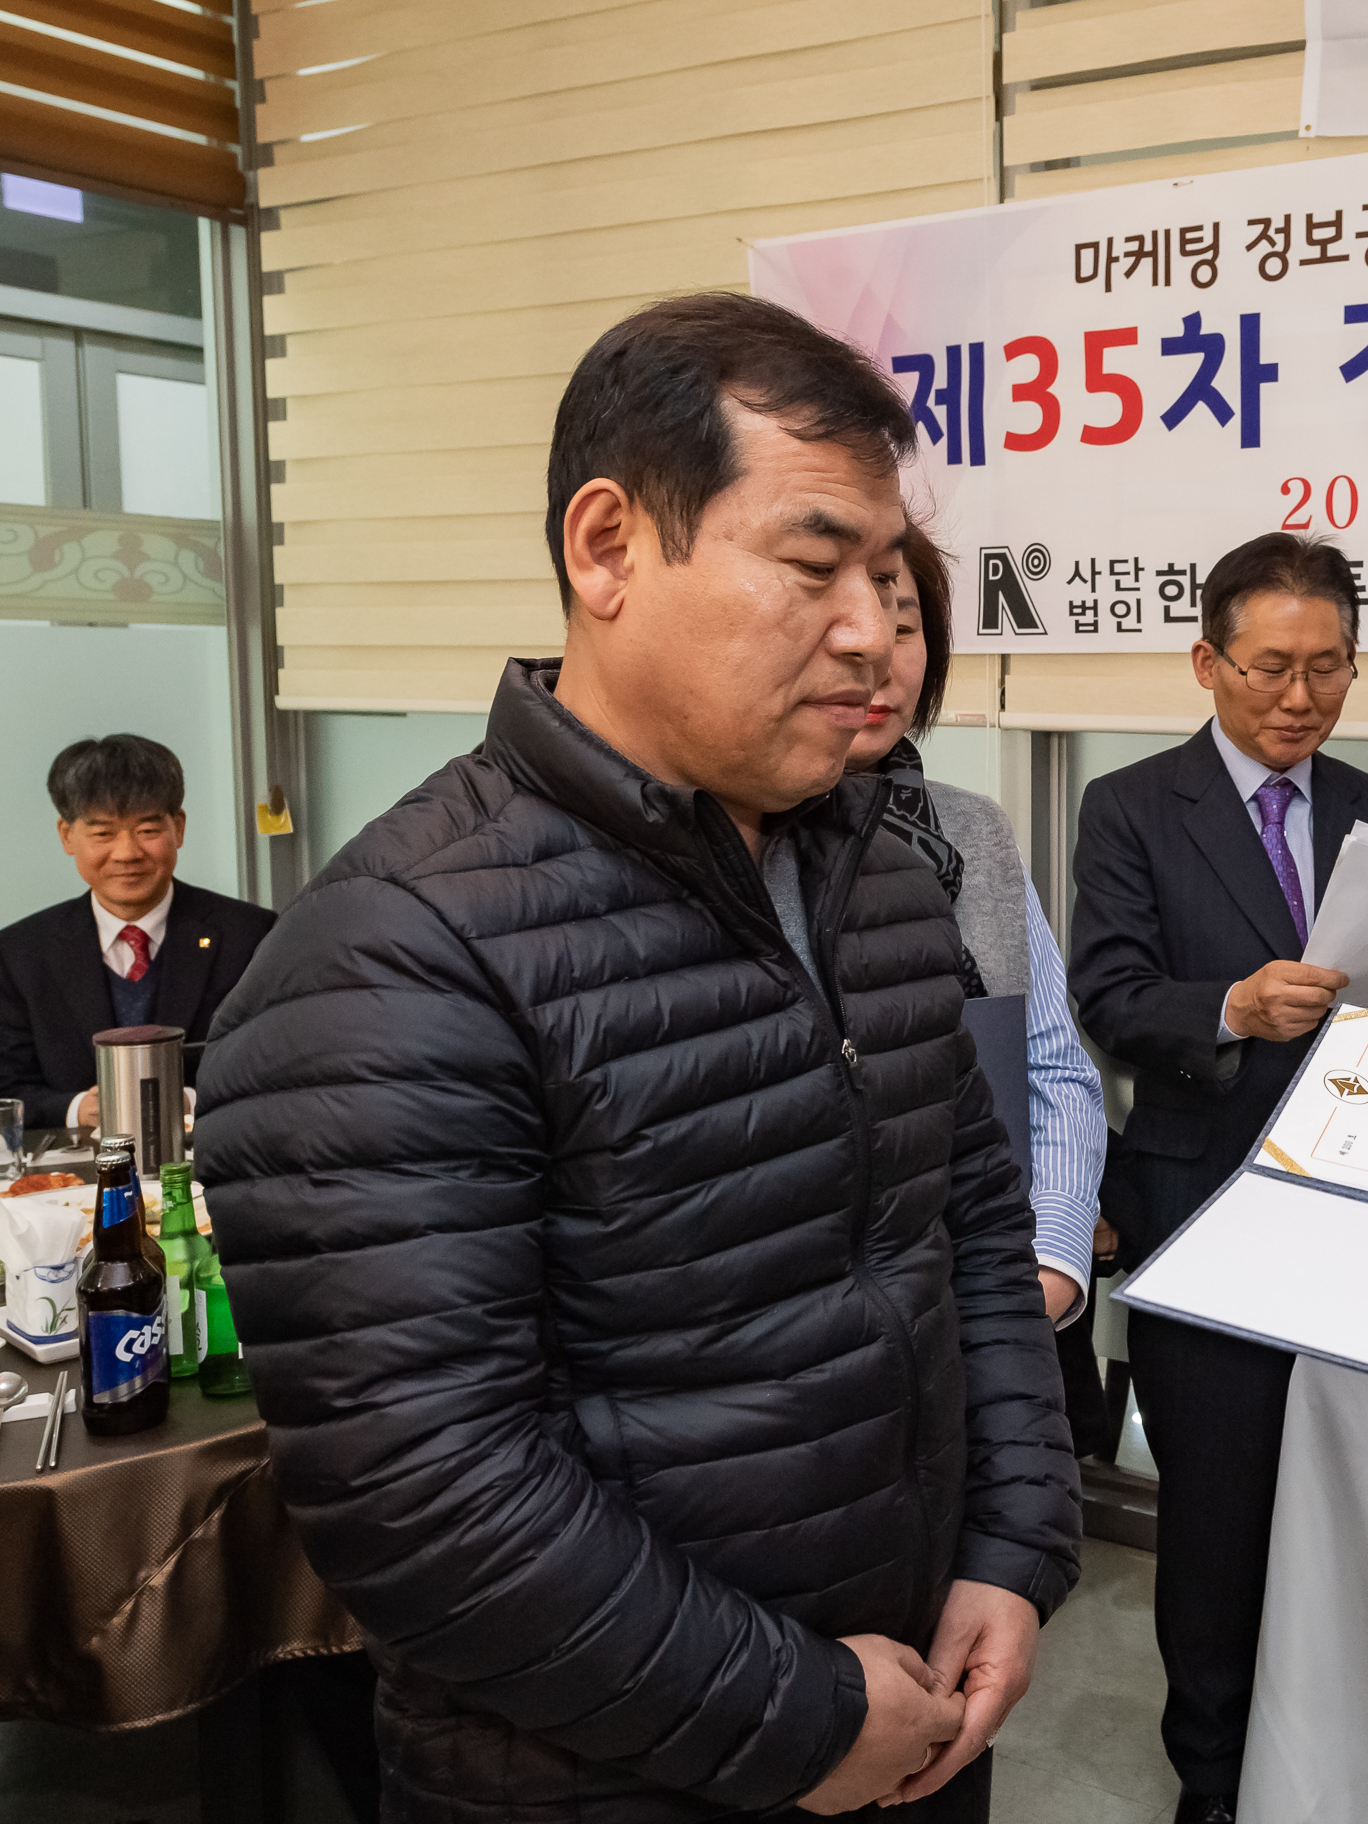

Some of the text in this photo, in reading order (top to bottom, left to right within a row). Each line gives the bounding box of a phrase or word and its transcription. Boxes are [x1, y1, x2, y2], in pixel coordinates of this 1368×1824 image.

[1075, 221, 1220, 293] 마케팅
[892, 312, 1278, 465] 제35차
[1066, 556, 1145, 593] 사단
[1068, 598, 1143, 634] 법인
